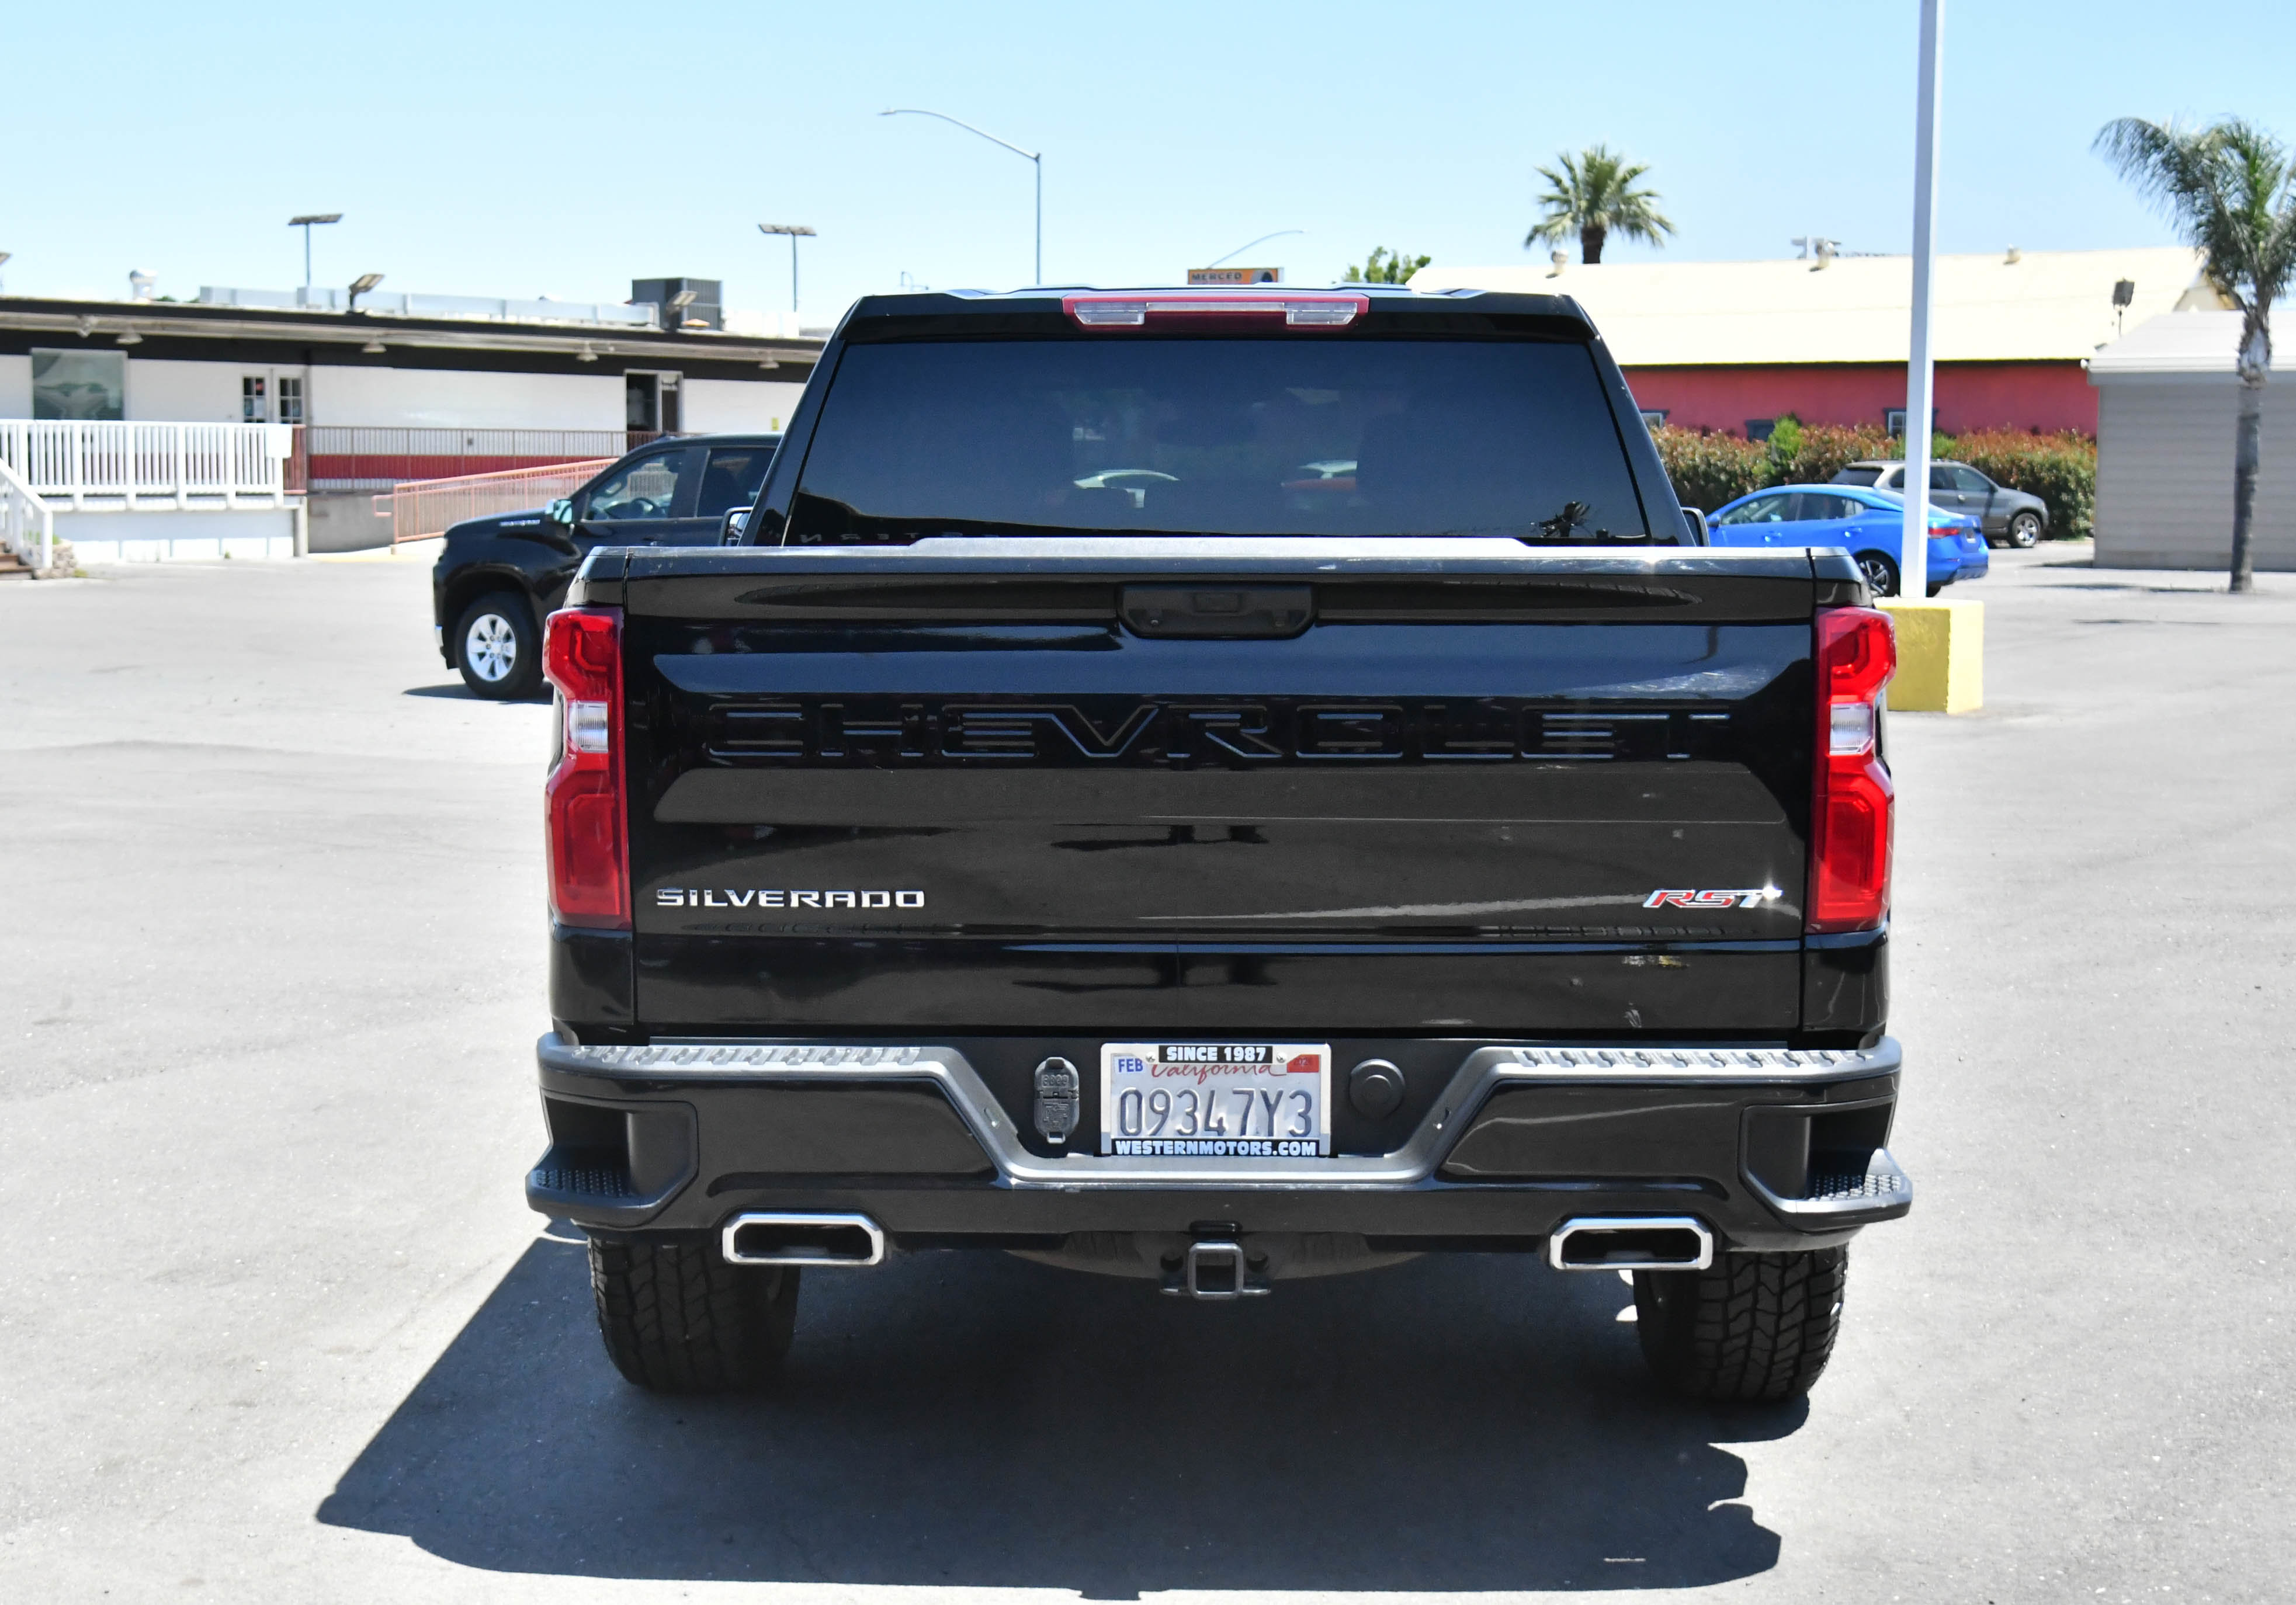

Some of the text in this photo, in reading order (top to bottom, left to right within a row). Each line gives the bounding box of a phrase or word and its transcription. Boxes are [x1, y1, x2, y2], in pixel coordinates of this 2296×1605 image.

[708, 703, 1730, 759] CHEVROLET
[657, 888, 925, 908] SILVERADO
[1642, 889, 1783, 908] RST
[1166, 1046, 1267, 1062] SINCE 1987
[1118, 1058, 1143, 1073] FEB
[1119, 1088, 1313, 1137] 09347Y3
[1115, 1140, 1316, 1156] WESTERNMOTORS.COM
